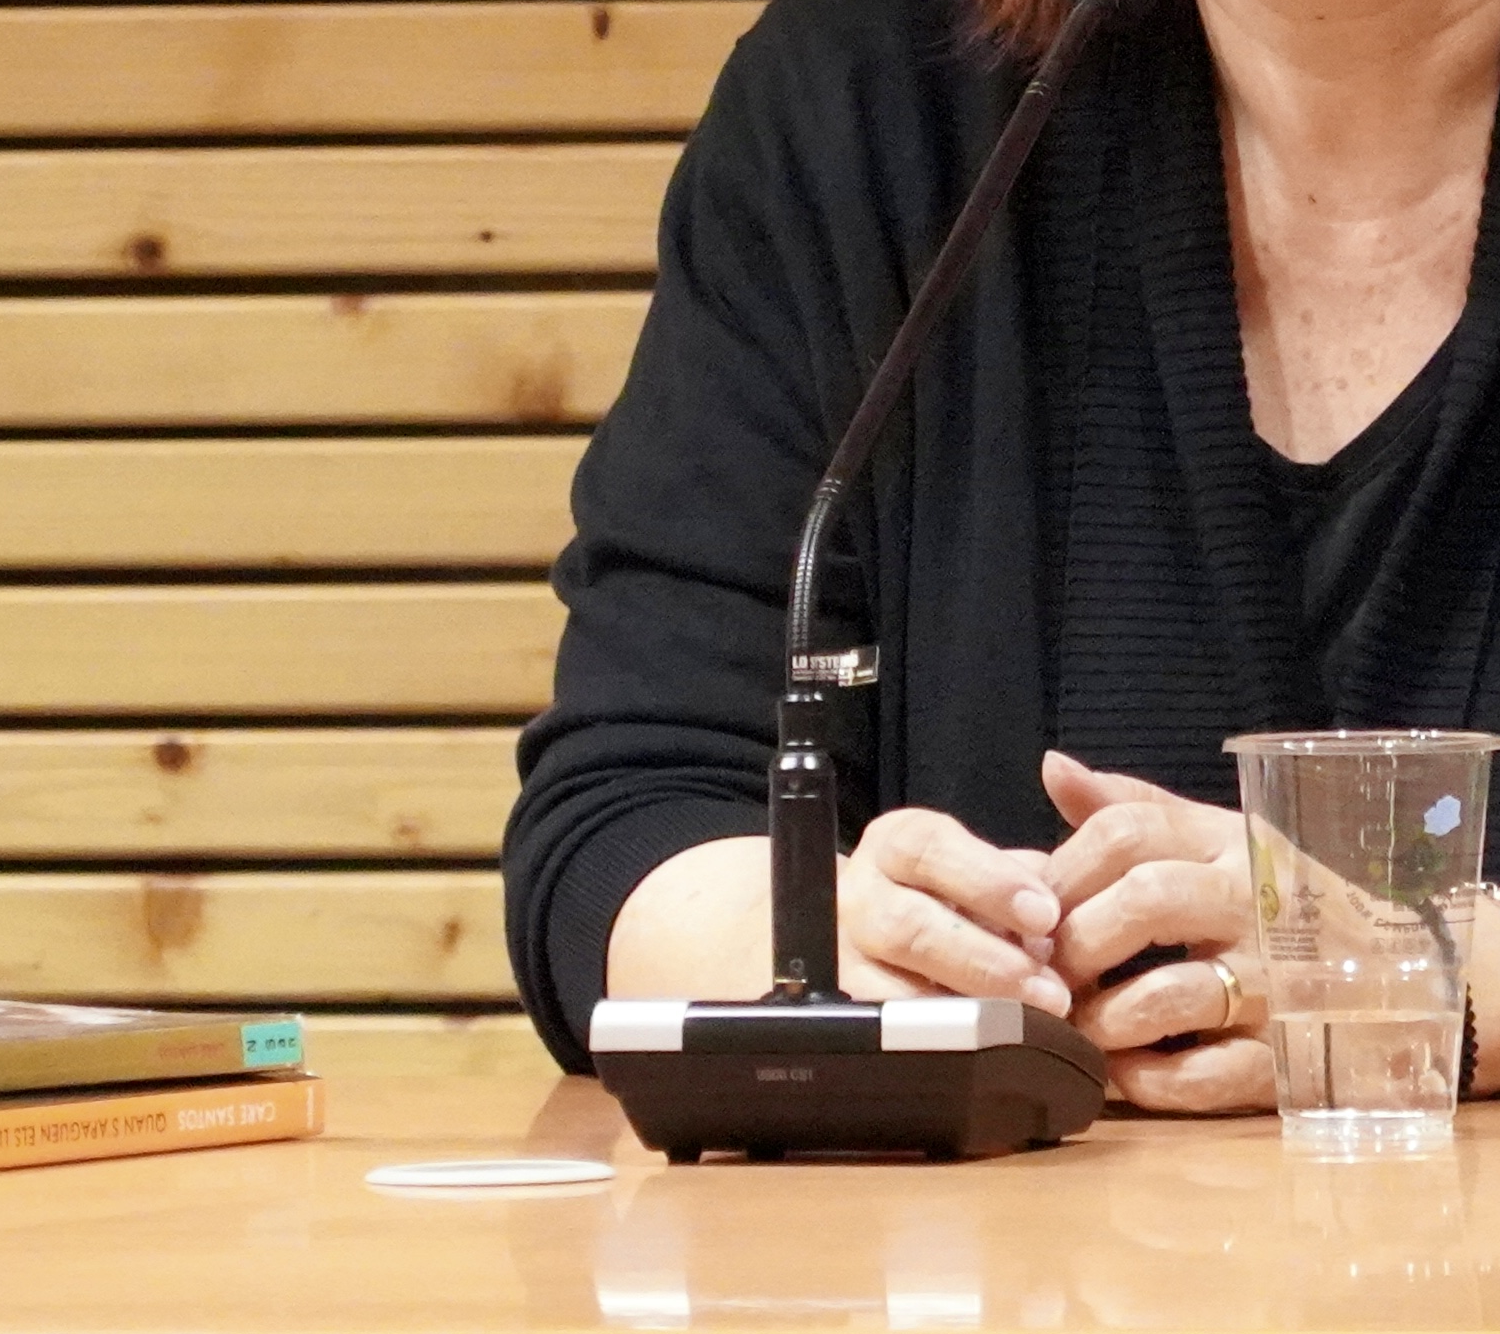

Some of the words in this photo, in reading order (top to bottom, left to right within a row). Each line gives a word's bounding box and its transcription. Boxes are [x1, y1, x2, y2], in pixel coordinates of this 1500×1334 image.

[123, 1112, 168, 1135] QUAN
[176, 1105, 236, 1132] SANTOS
[239, 1100, 277, 1127] CARE
[12, 1125, 37, 1147] ELS
